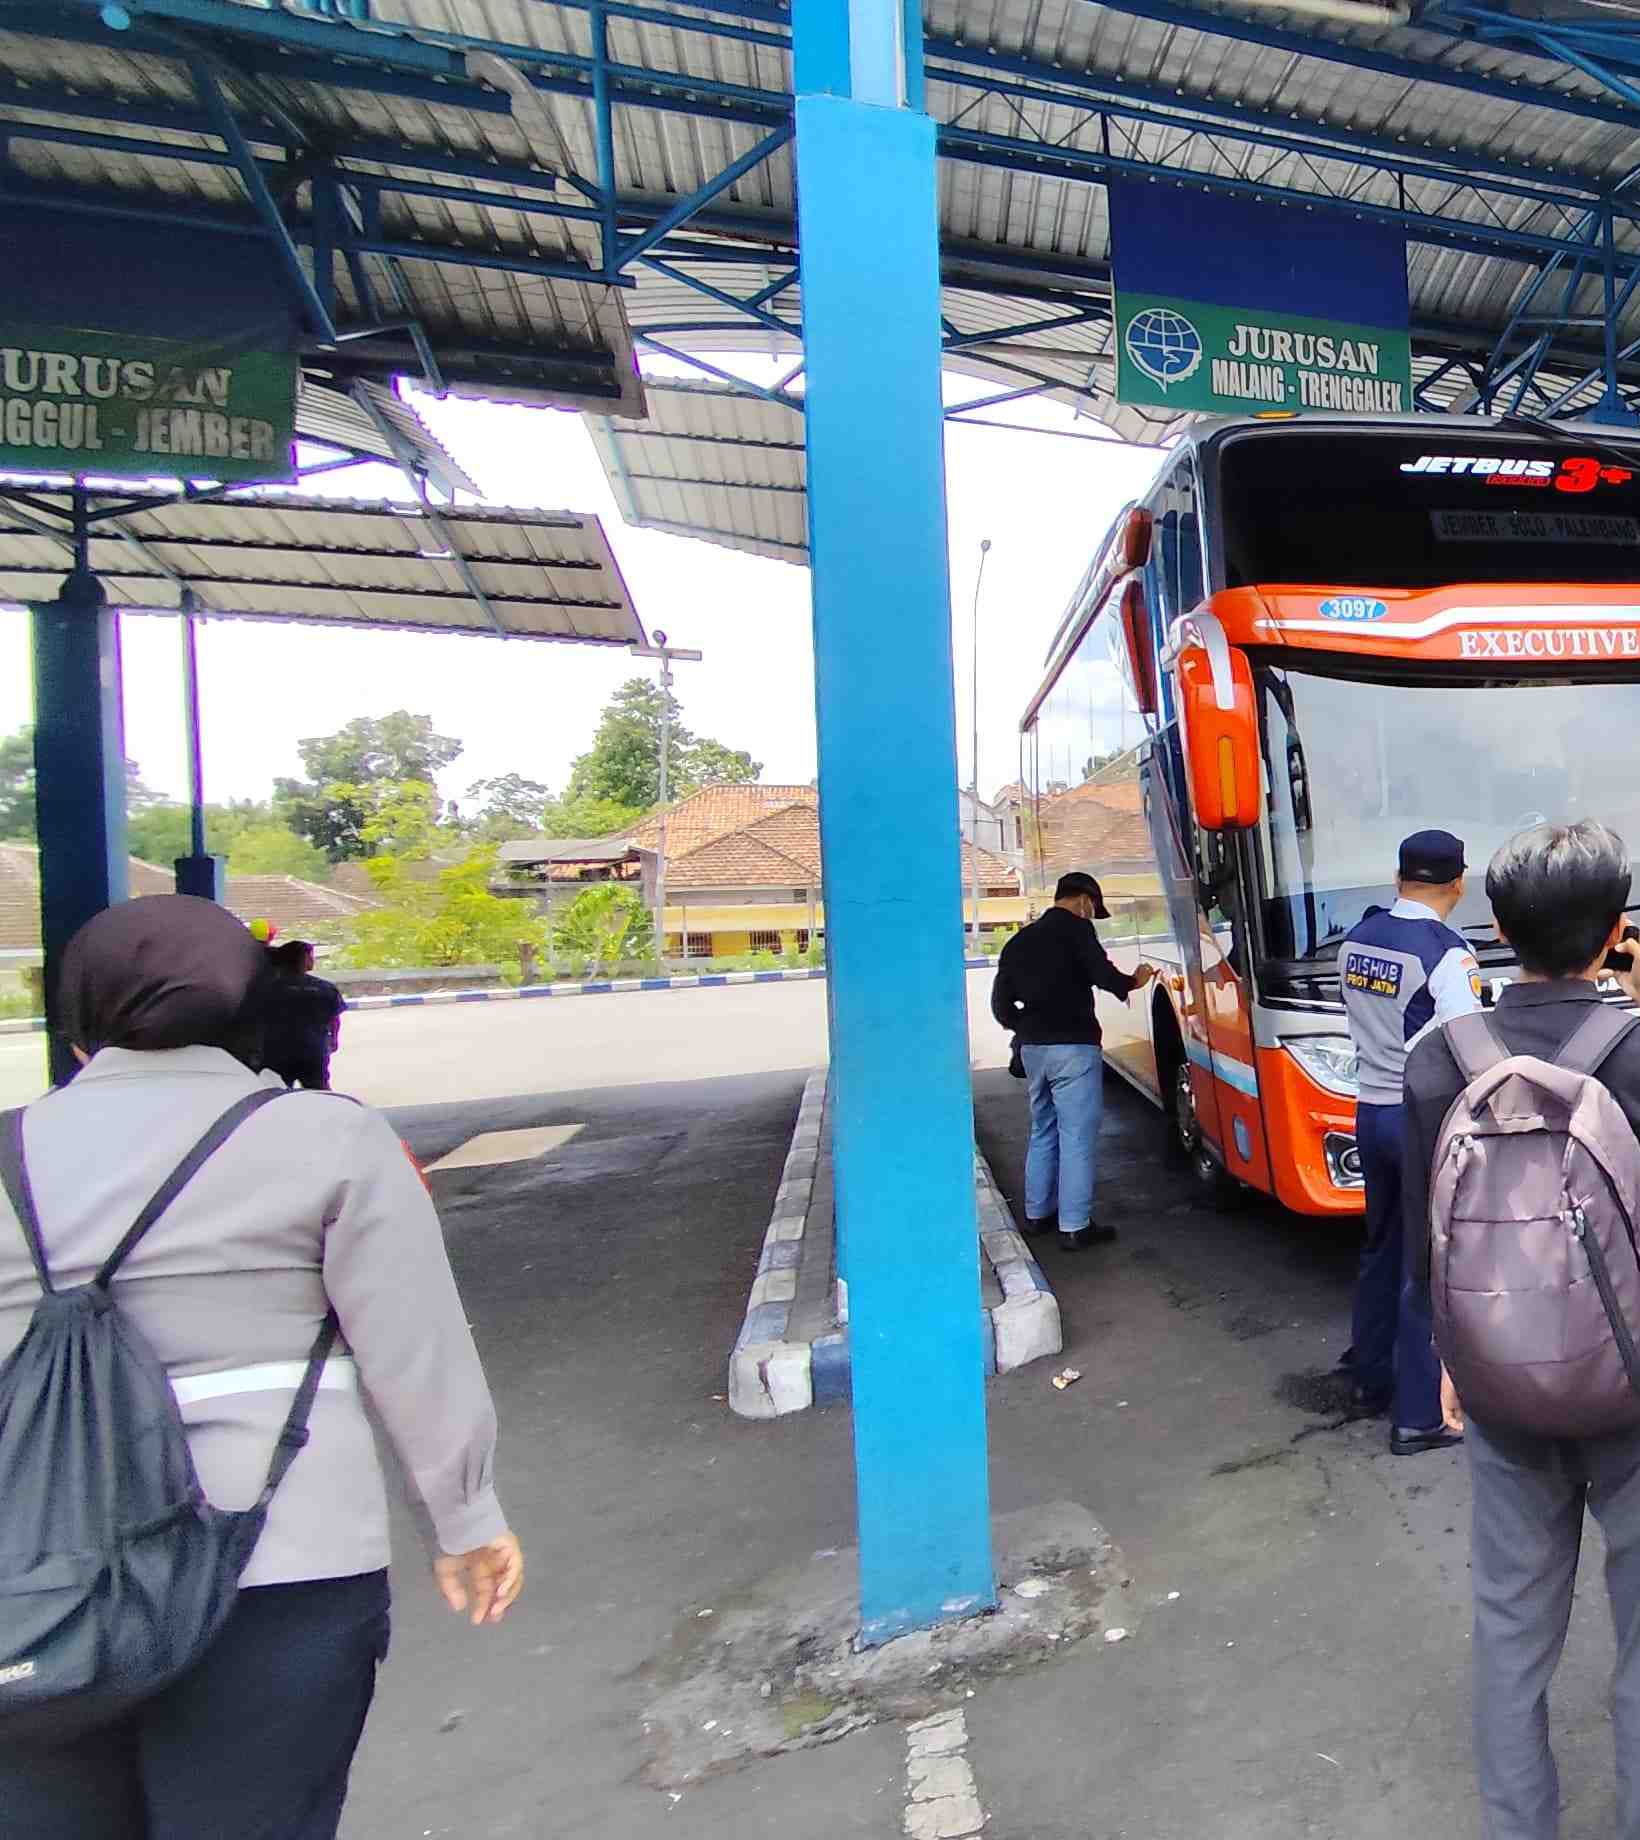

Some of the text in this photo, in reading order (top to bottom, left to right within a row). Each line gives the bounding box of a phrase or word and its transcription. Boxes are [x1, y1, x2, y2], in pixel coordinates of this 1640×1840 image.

[1229, 325, 1378, 373] JURUSAN
[0, 347, 231, 407] URUSAN
[1211, 357, 1285, 402] MALANG
[1298, 370, 1401, 412] TRENGGALEK
[0, 398, 104, 450] GGUL
[134, 407, 274, 461] JEMBER
[1400, 457, 1555, 477] JETBUS
[1329, 600, 1377, 618] 3097
[1457, 629, 1640, 657] EXECUTIVE
[1348, 955, 1399, 982] DISHUB
